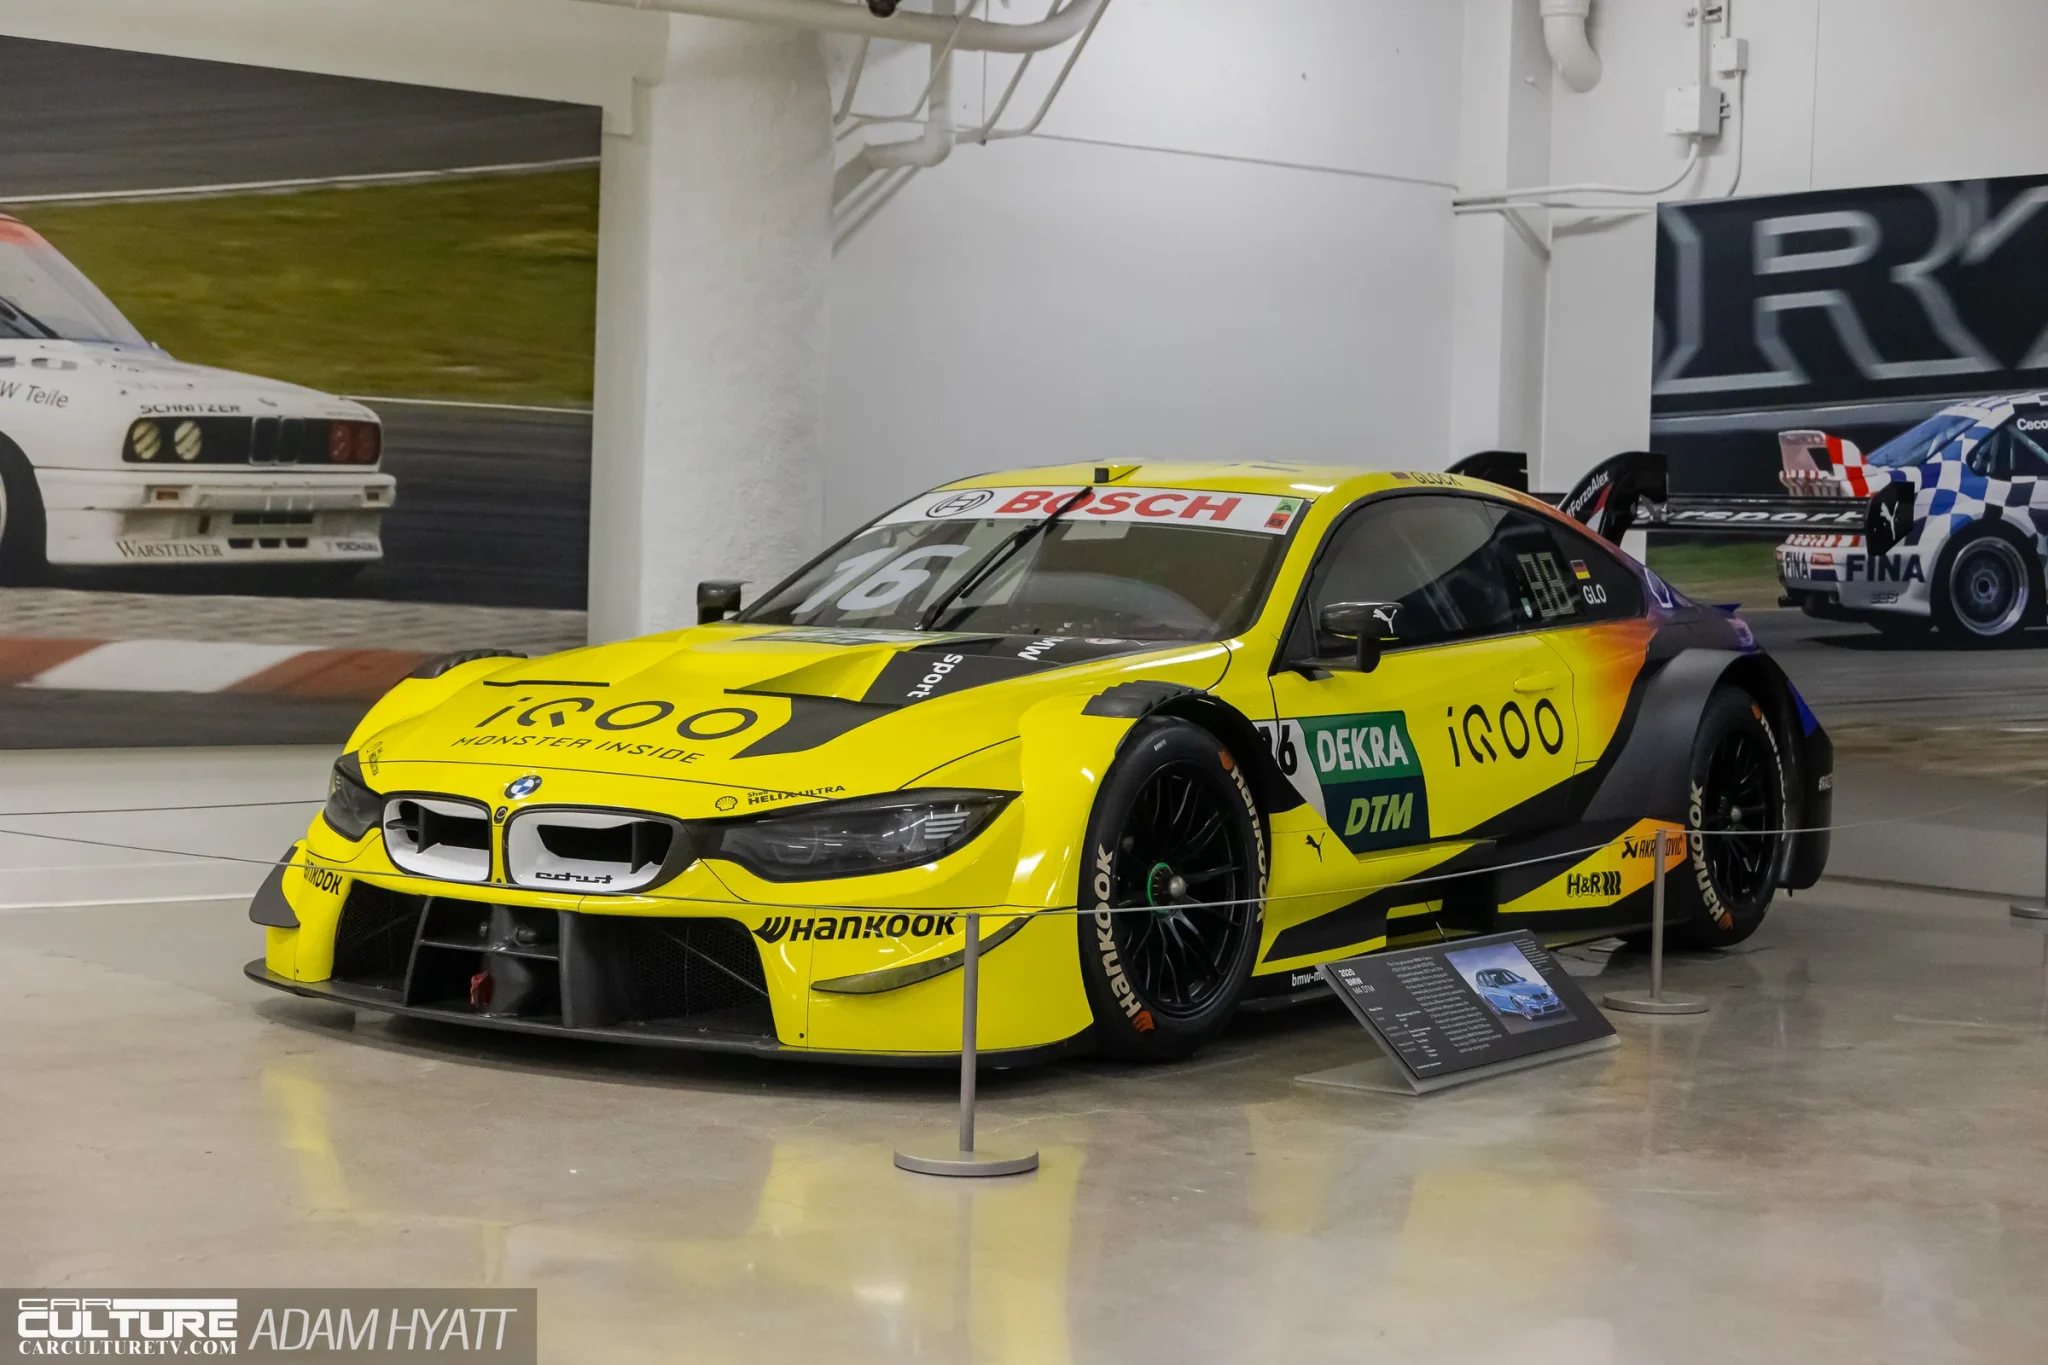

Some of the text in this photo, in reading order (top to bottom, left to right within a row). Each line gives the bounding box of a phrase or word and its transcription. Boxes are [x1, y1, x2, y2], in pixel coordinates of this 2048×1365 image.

[25, 384, 70, 409] Teile
[140, 403, 241, 415] SCHNITZER
[994, 490, 1242, 521] BOSCH
[1664, 506, 1864, 523] rsport
[116, 539, 224, 559] WARSTEINER
[789, 543, 972, 615] 16
[1845, 553, 1926, 582] FINA
[1582, 583, 1607, 605] GLO
[907, 653, 964, 700] sport
[451, 734, 705, 764] MONSTER INSIDE
[1316, 724, 1410, 774] DEKRA
[747, 784, 846, 806] HELIX ULTRA
[1343, 792, 1414, 837] DTM
[1566, 872, 1604, 898] H&R
[1345, 976, 1363, 987] BMW
